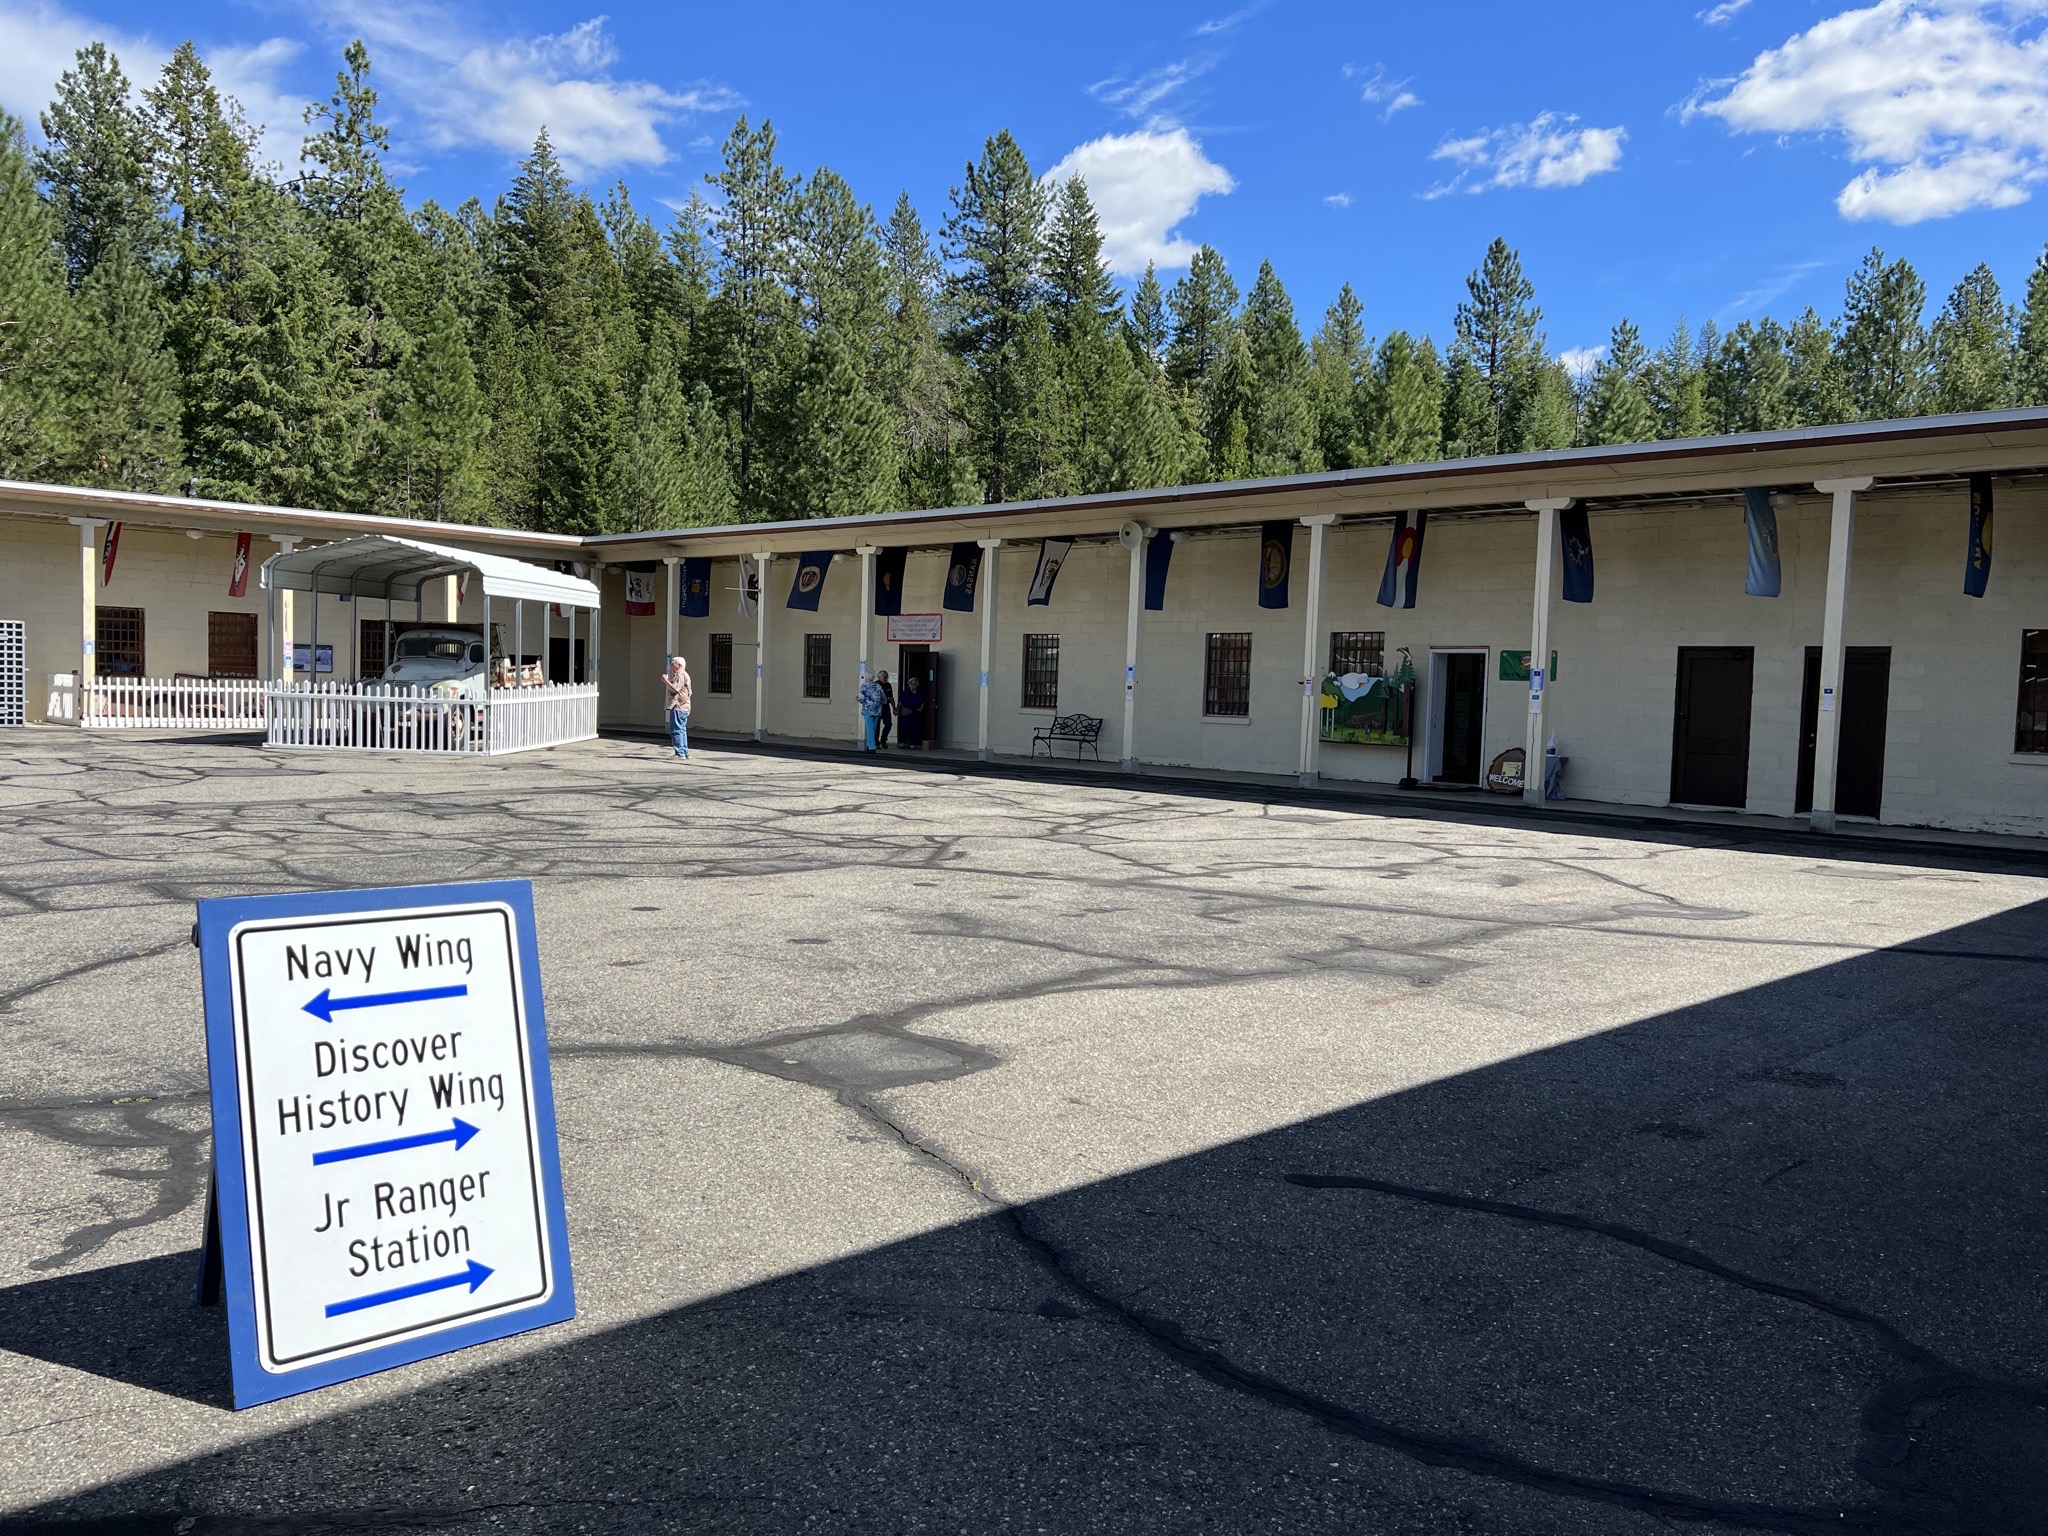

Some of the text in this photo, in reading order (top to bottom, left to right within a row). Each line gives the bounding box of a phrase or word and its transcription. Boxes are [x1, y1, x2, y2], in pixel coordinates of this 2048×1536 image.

[1489, 773, 1525, 788] WELCOME
[286, 934, 473, 983] Navy Wing
[314, 1031, 462, 1078] Discover
[278, 1072, 504, 1136] History Wing
[313, 1171, 490, 1234] Jr Ranger
[348, 1225, 470, 1278] Station
